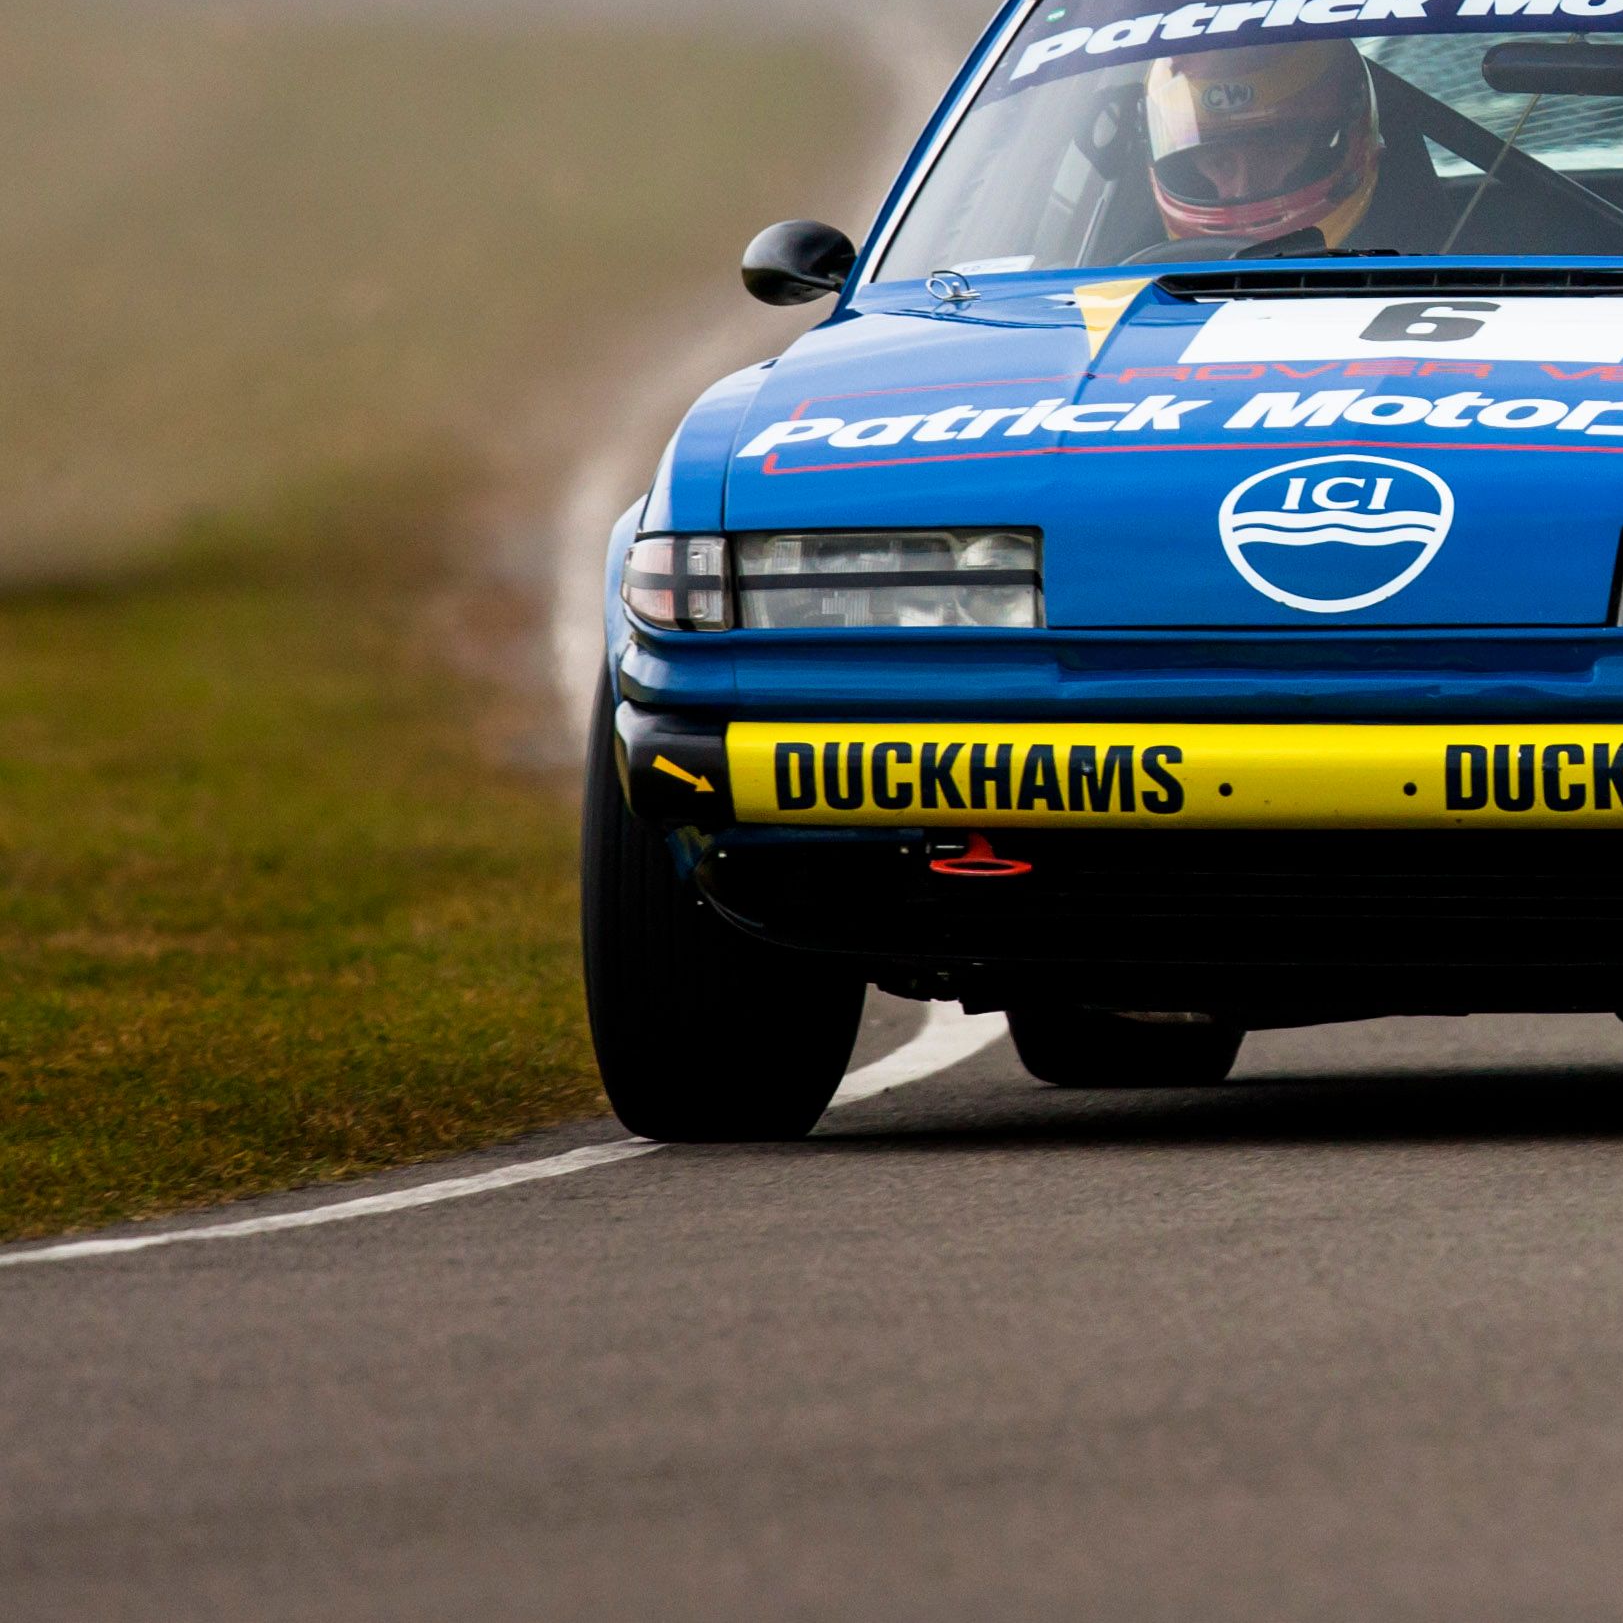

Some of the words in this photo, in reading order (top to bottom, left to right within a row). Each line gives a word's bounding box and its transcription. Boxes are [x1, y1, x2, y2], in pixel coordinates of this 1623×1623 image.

[1359, 300, 1502, 343] 6
[736, 393, 1213, 459] Patrick
[1281, 477, 1394, 511] ICI
[774, 741, 1185, 814] DUCKHAMS
